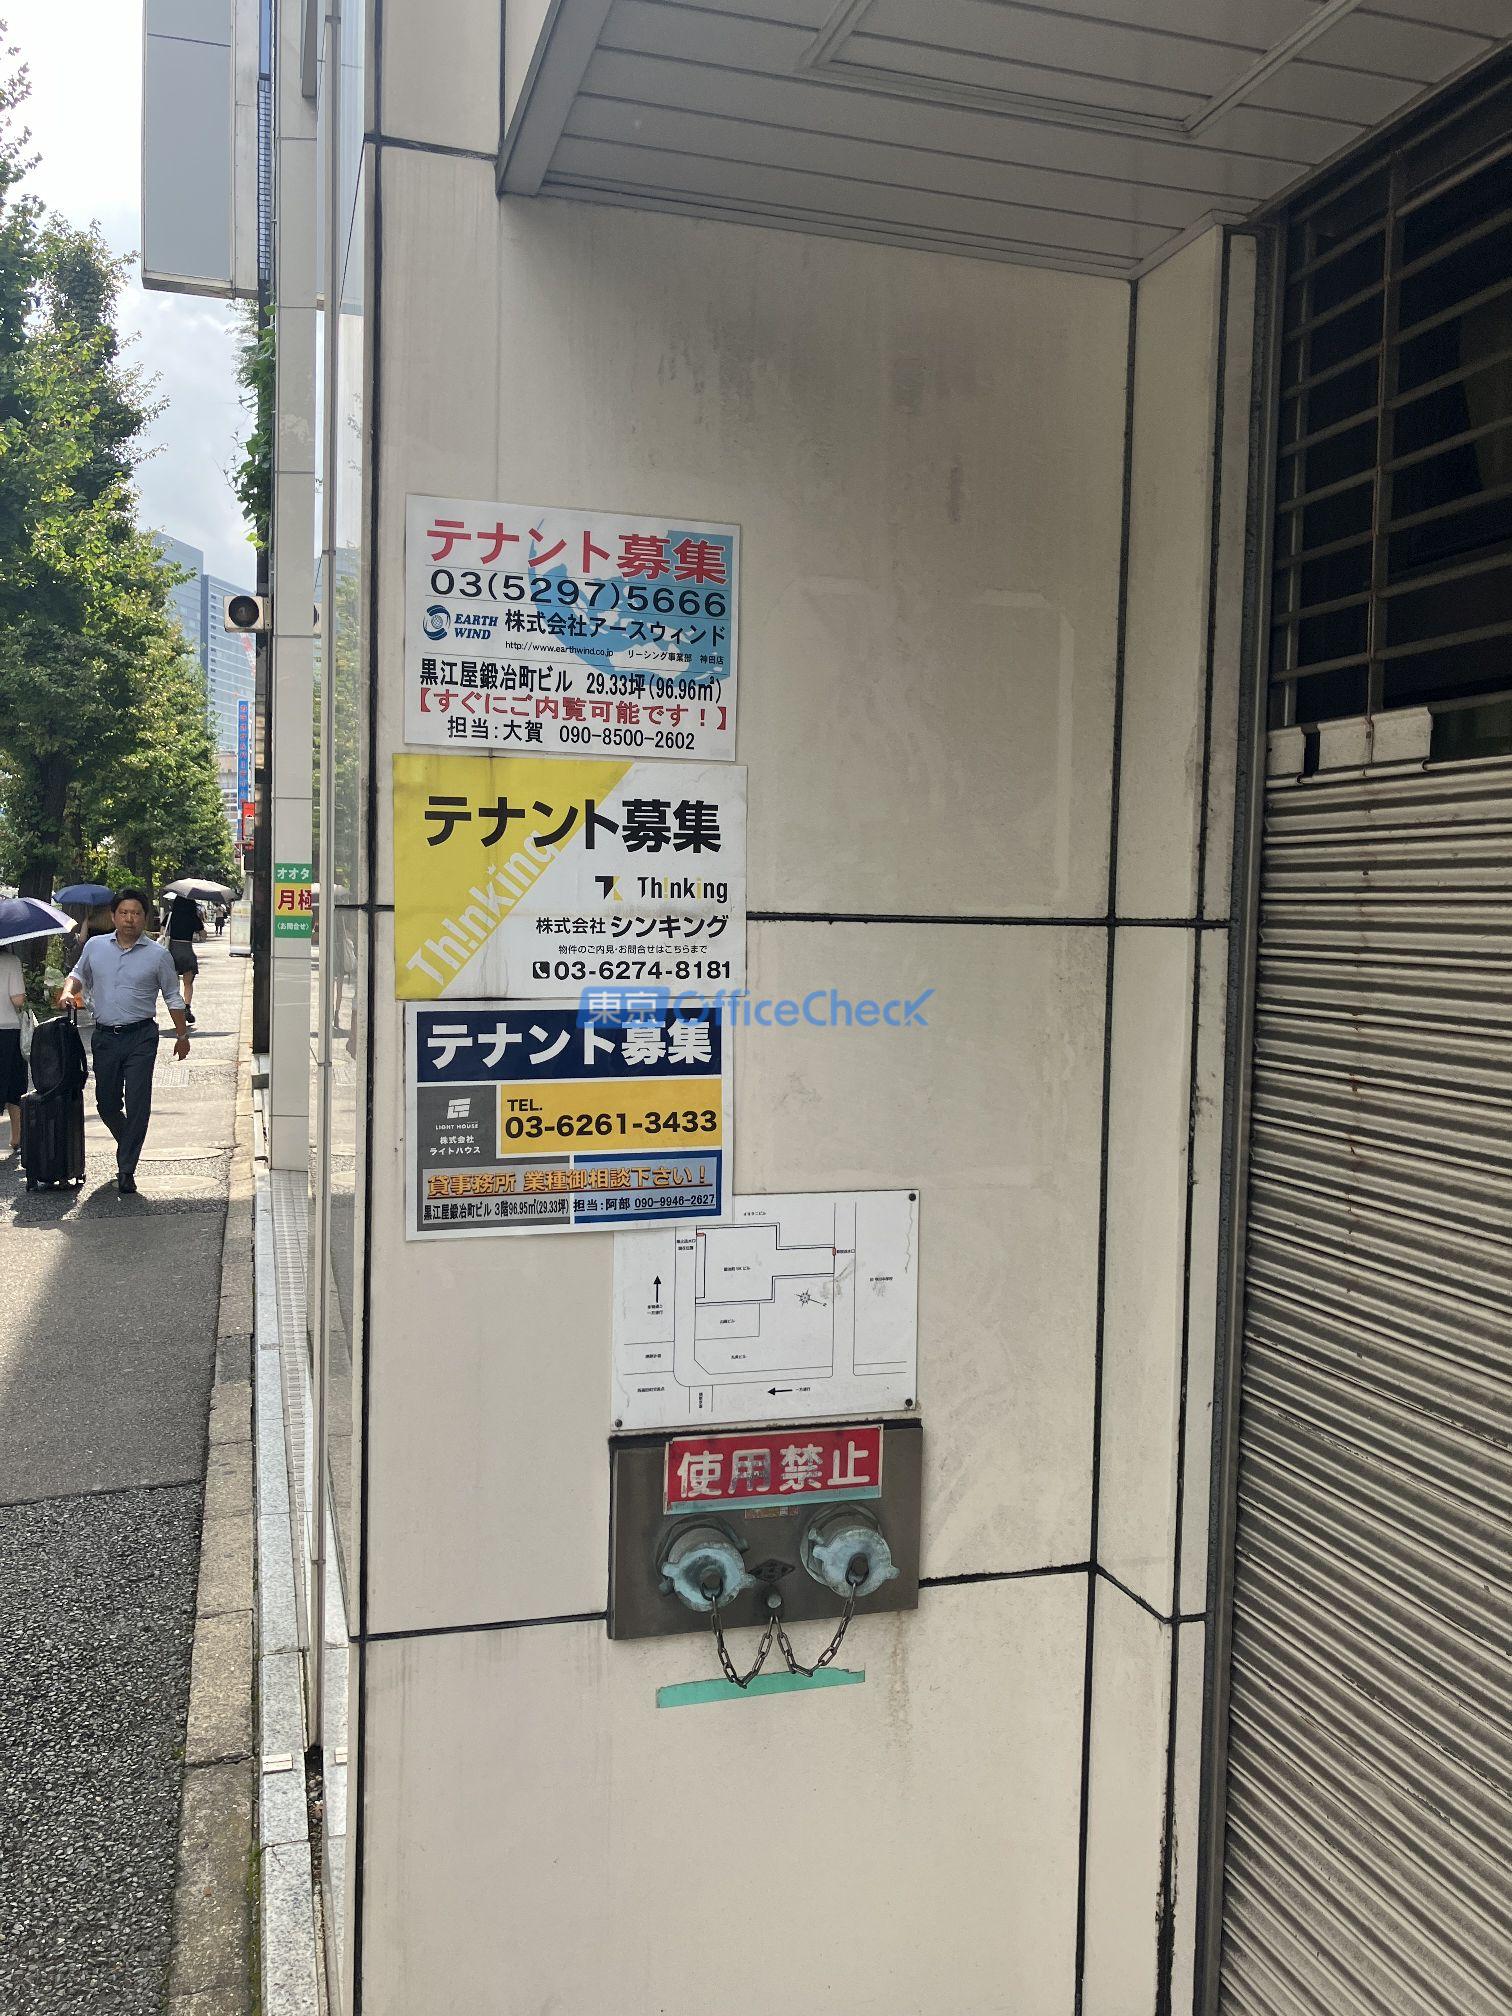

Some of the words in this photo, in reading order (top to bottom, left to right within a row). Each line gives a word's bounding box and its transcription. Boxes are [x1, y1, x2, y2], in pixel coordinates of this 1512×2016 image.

[427, 519, 728, 585] テナント募集
[430, 568, 727, 617] 03(5297)5666
[454, 613, 498, 627] EARTH
[505, 608, 726, 647] 株式会社アースウィンド
[455, 626, 491, 640] WIND
[505, 641, 614, 657] http://www.earthwind.co.jp
[628, 649, 692, 663] リーシング事業部
[700, 654, 725, 665] 神田店
[420, 658, 572, 693] 黒江屋鍛冶町ビル
[559, 725, 695, 750] 090-8500-2602
[424, 795, 722, 854] テナント募集
[536, 916, 606, 935] 株式会社
[610, 915, 729, 939] シンキング
[554, 960, 731, 980] 03-6274-8181
[427, 1017, 713, 1070] テナント募集
[507, 1098, 543, 1112] TEL.
[505, 1110, 718, 1140] 03-6261-3433
[429, 1146, 481, 1156] ライトハウス
[439, 1135, 475, 1144] 株式会社
[427, 1172, 517, 1196] 貸事務所
[634, 1193, 715, 1209] 090-9946-2627
[676, 1440, 871, 1498] 使用禁止
